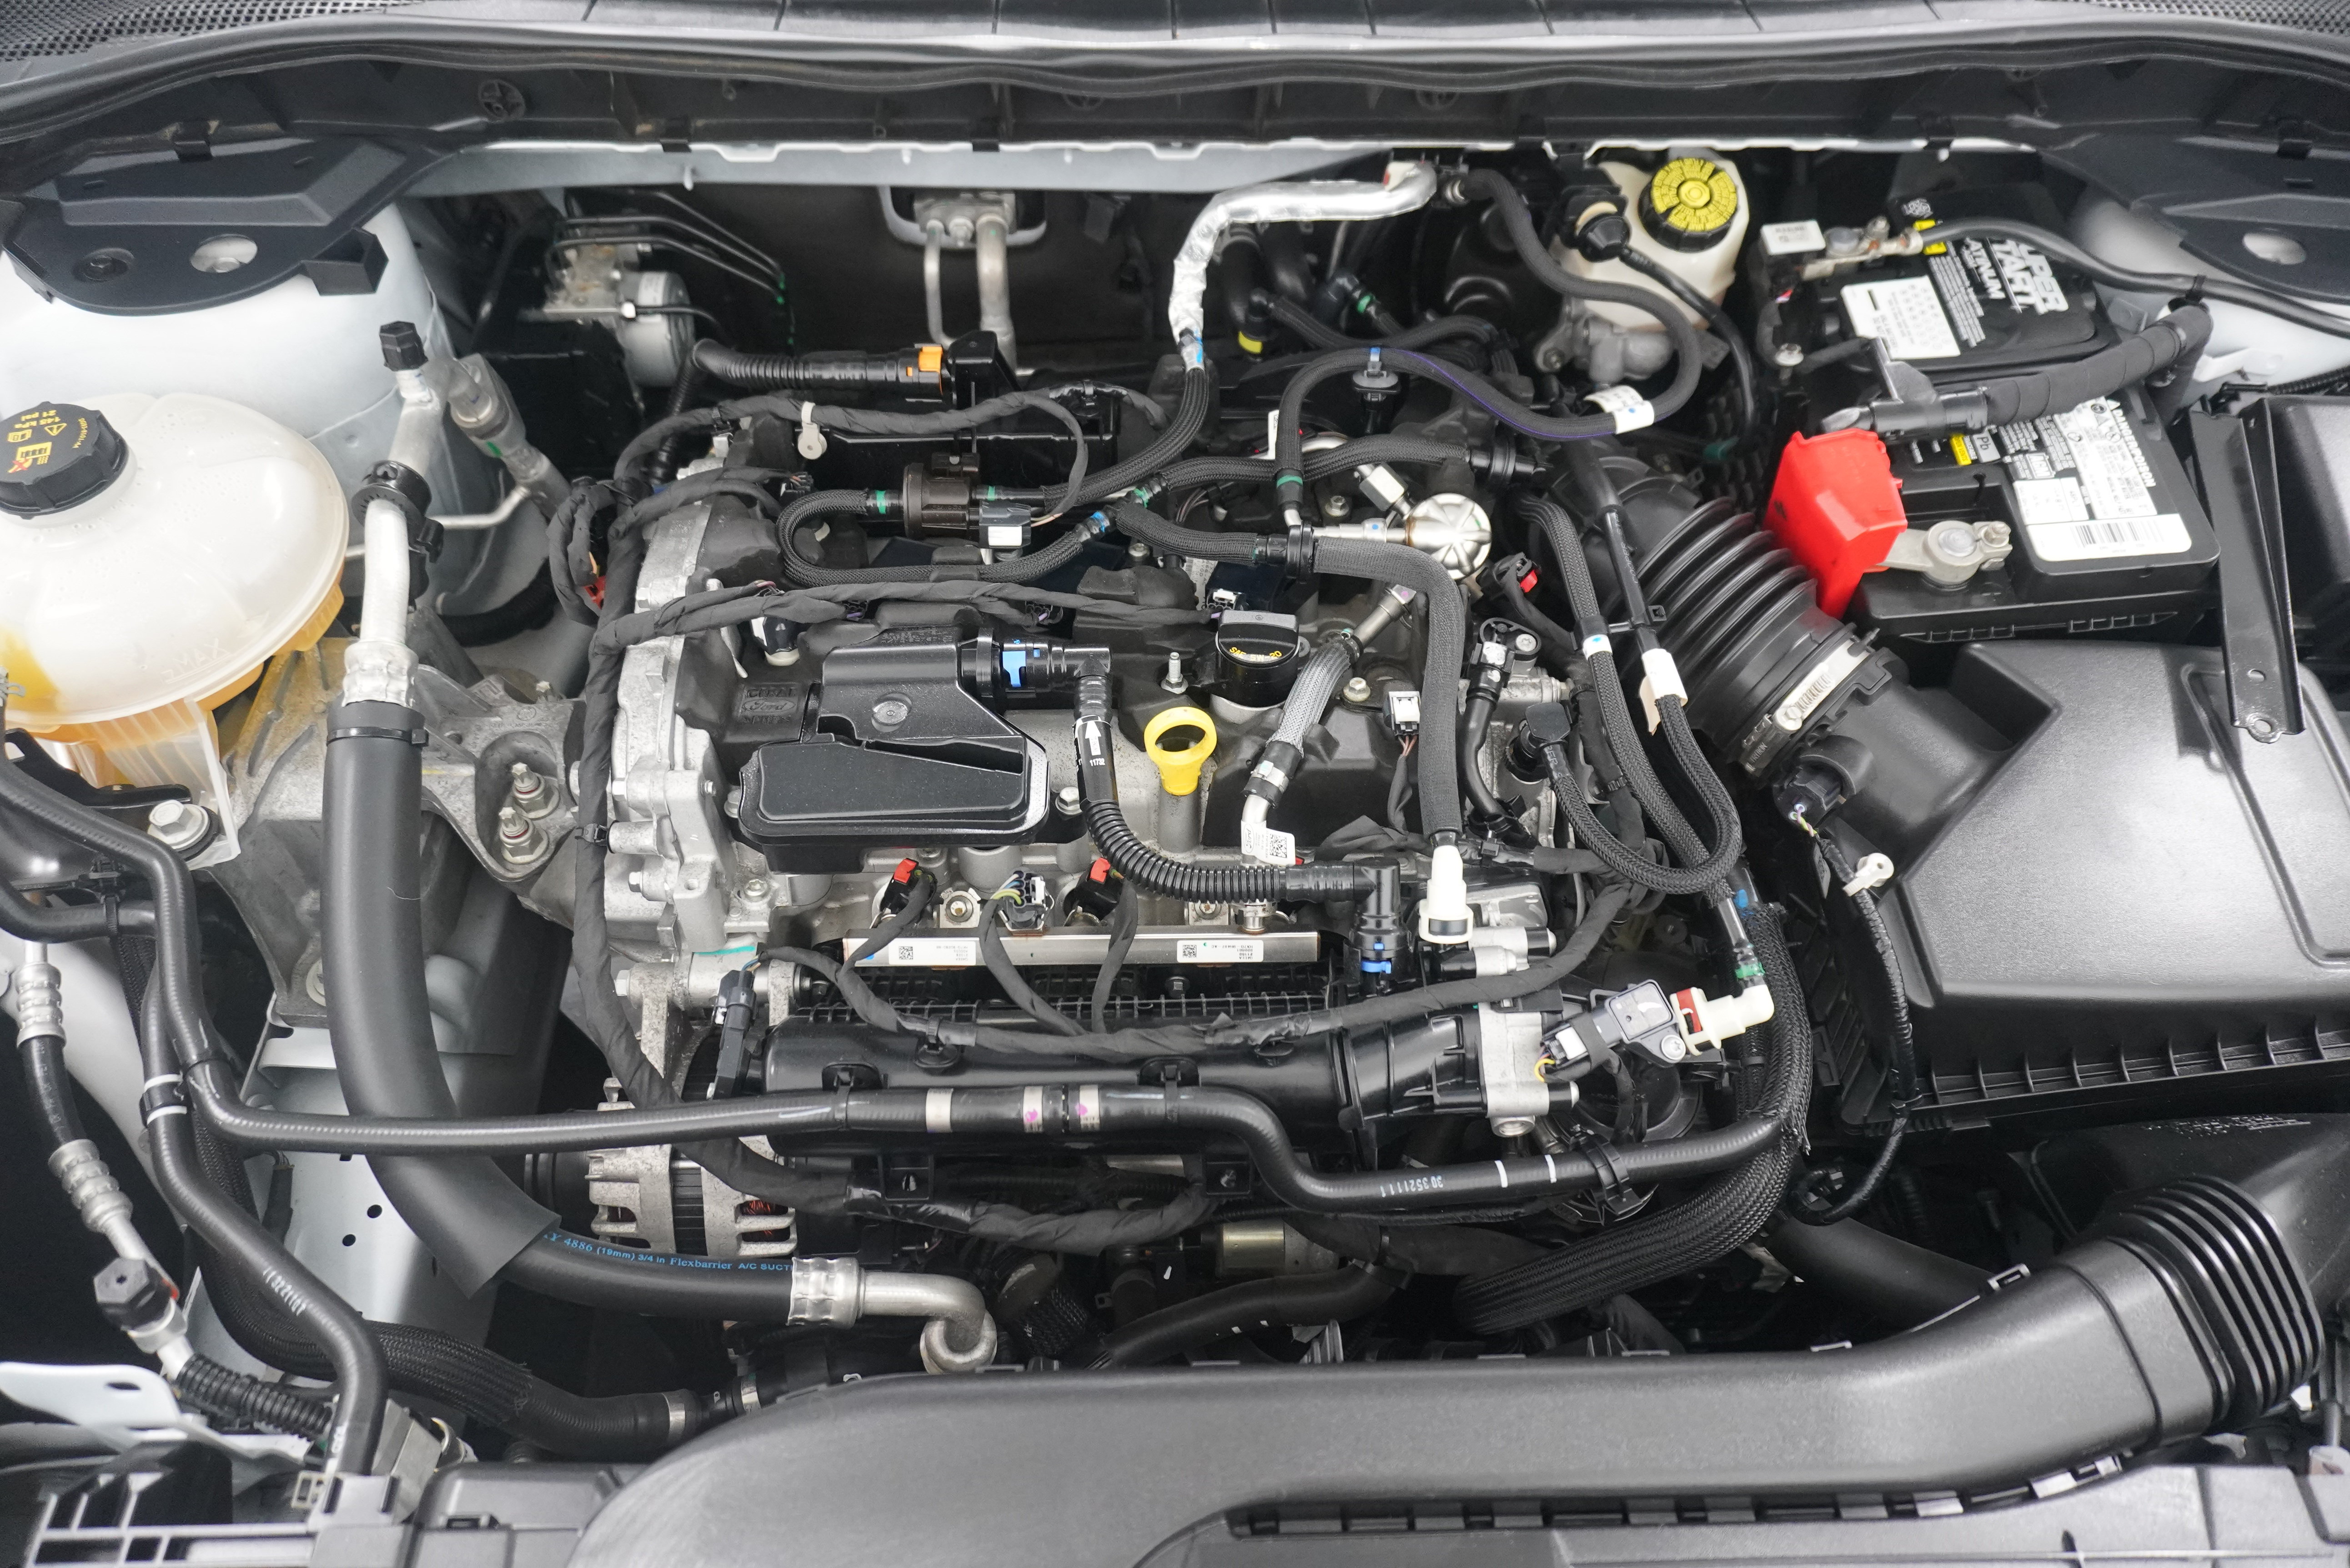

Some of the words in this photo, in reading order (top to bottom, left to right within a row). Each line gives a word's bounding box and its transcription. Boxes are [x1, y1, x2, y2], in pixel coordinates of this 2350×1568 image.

[2019, 243, 2070, 311] UPER
[20, 412, 39, 421] psi
[40, 417, 60, 425] 145
[1977, 436, 1992, 451] Pb
[2111, 409, 2157, 488] DANGER/POISON
[2029, 455, 2051, 477] AGM
[1621, 542, 1638, 583] COOPER
[1229, 647, 1246, 658] SAE
[1251, 650, 1282, 662] 5W-20
[1090, 758, 1105, 766] 11732
[1431, 1175, 1443, 1188] 30
[564, 1238, 593, 1252] 4886
[597, 1246, 636, 1261] (19mm)
[638, 1254, 653, 1262] 3/4
[670, 1257, 732, 1270] Flexbarrier
